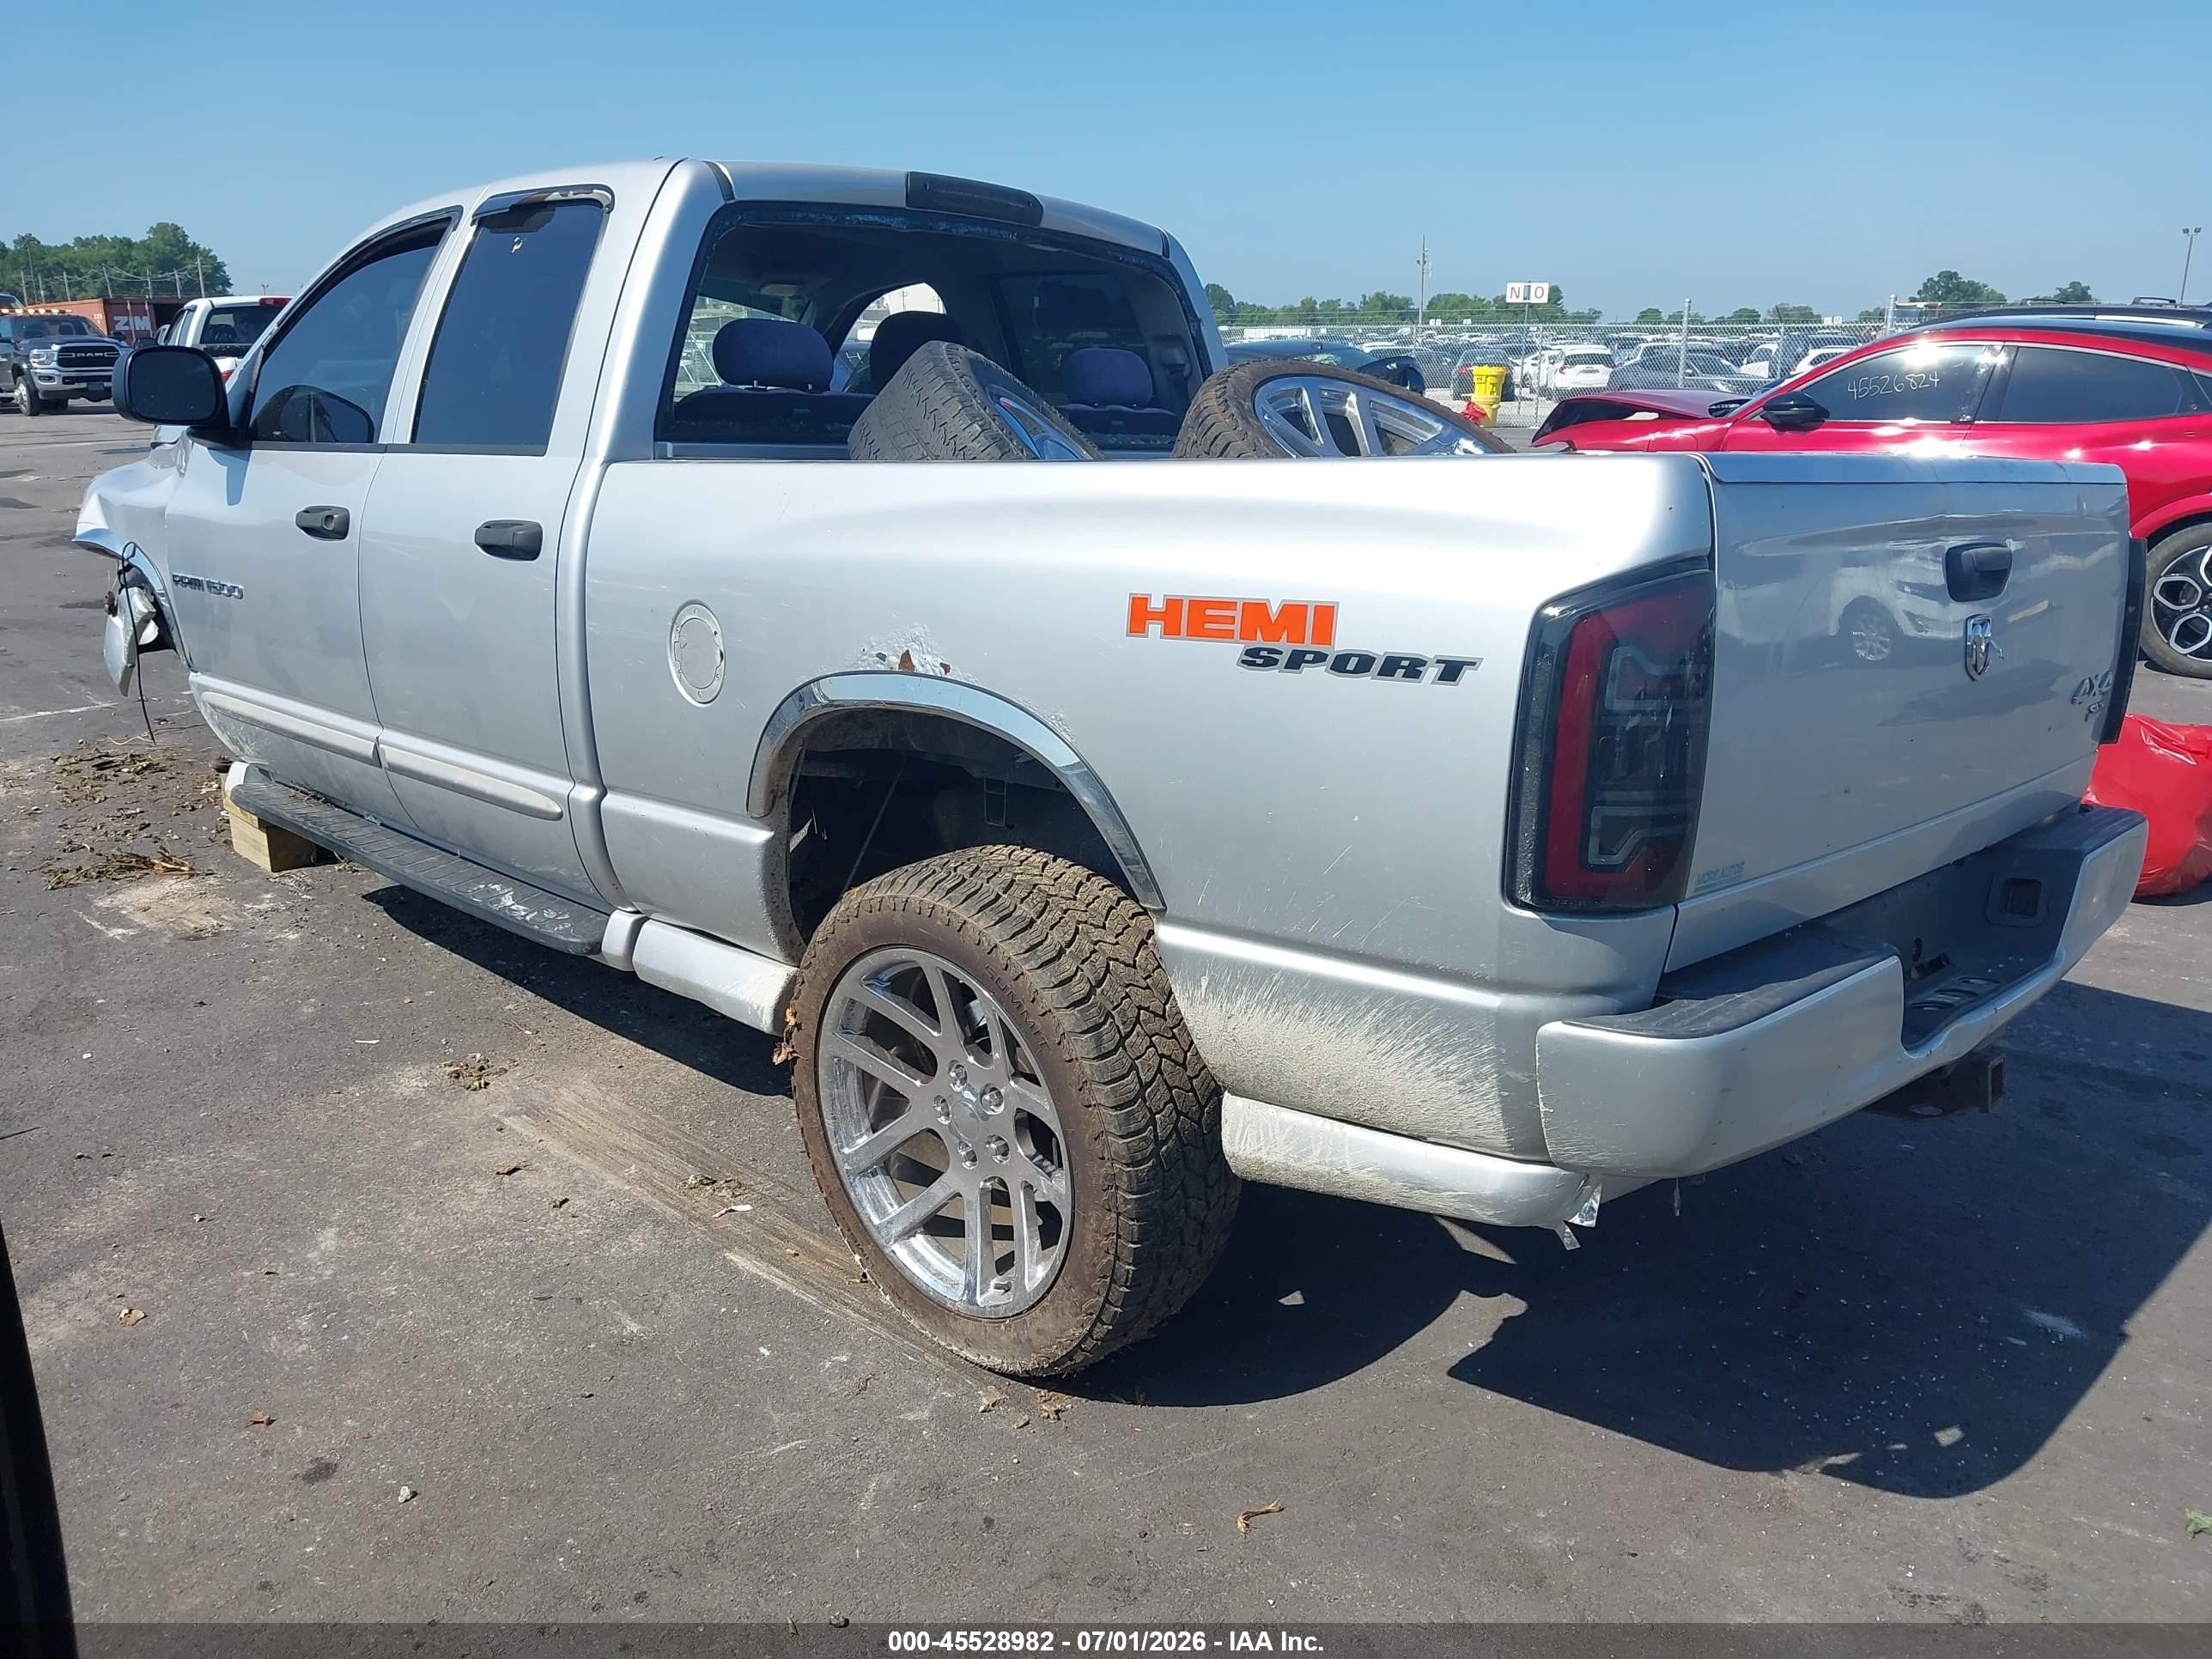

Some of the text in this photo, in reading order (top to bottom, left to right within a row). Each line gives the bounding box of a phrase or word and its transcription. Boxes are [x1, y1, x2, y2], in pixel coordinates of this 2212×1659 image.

[1510, 286, 1521, 299] N
[113, 315, 151, 331] ZIM
[1847, 370, 1941, 401] 45526824
[172, 573, 204, 592] RAM
[1126, 593, 1340, 647] HEMI
[1237, 645, 1484, 687] SPORT
[984, 963, 1051, 1050] SUMMIT
